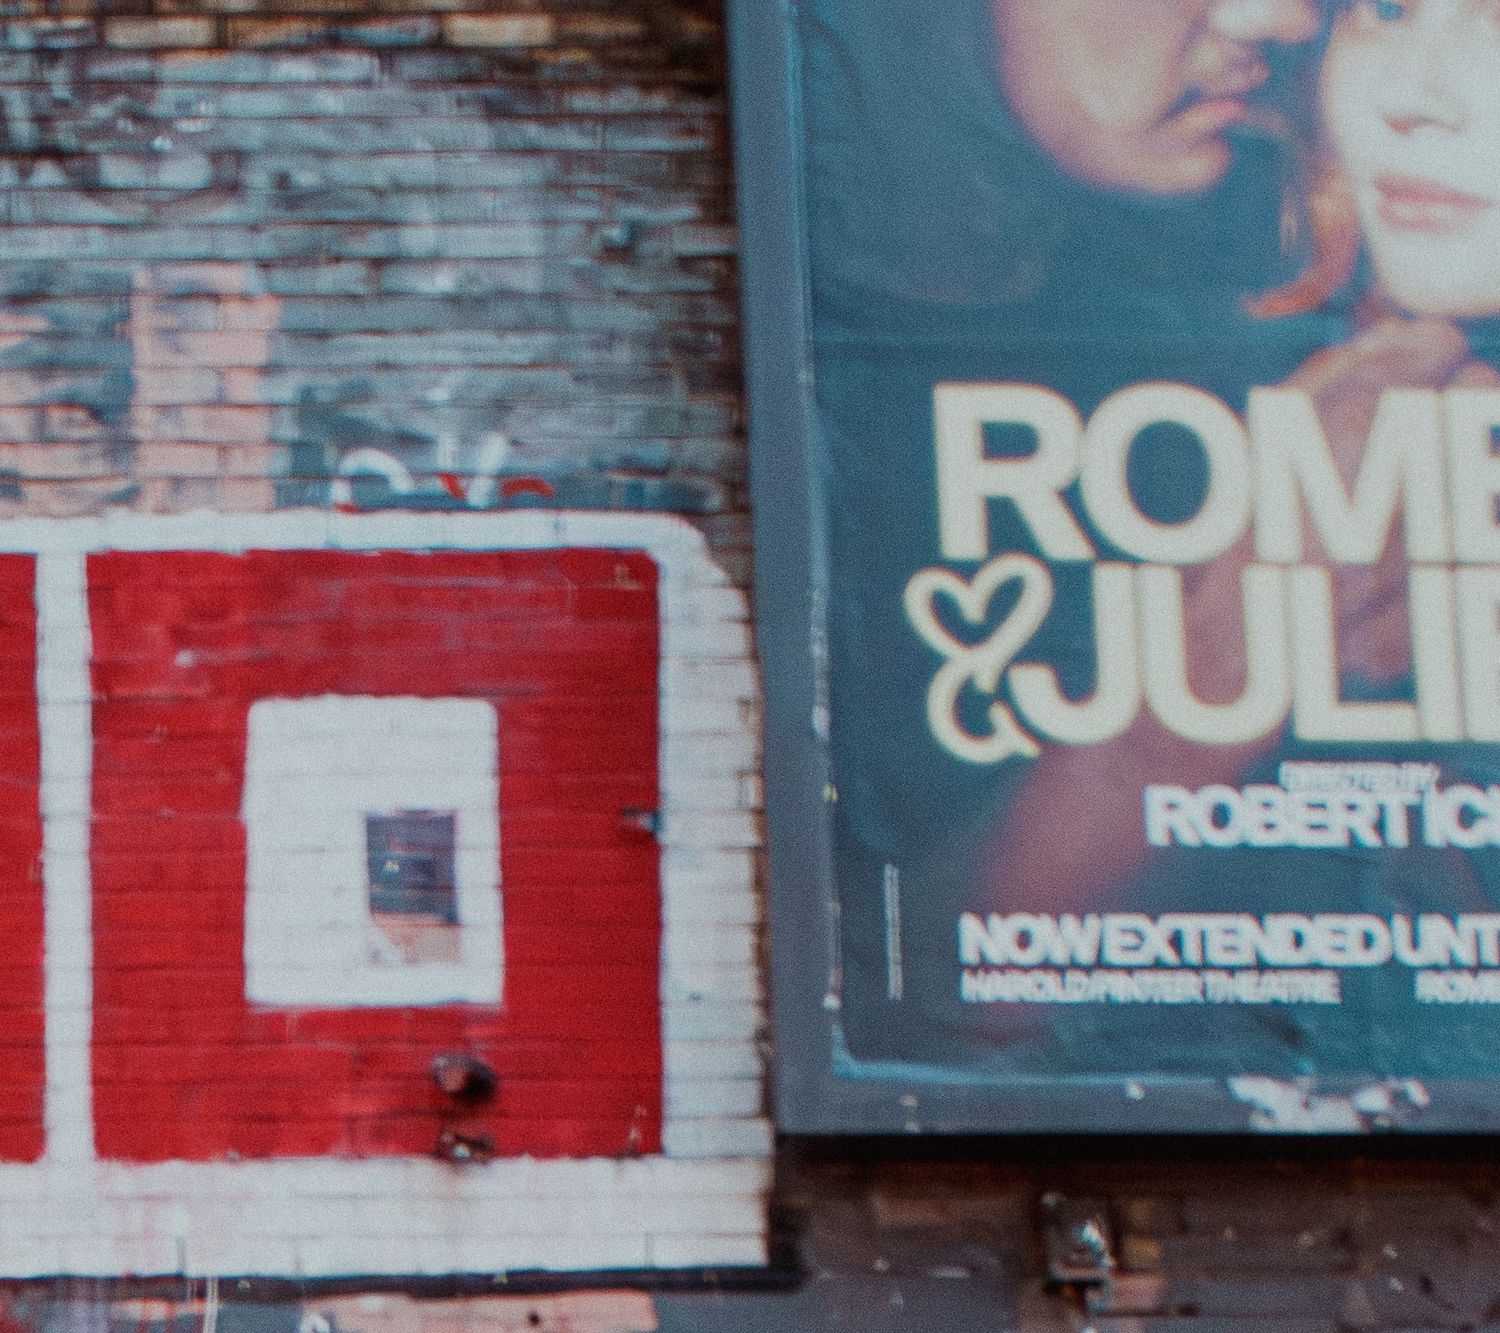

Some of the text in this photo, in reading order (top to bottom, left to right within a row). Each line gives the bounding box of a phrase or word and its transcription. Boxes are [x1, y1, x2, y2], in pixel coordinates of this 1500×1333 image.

[1145, 784, 1406, 849] ROBERT
[959, 913, 1104, 968] NOW
[1103, 913, 1393, 970] EXTENDED
